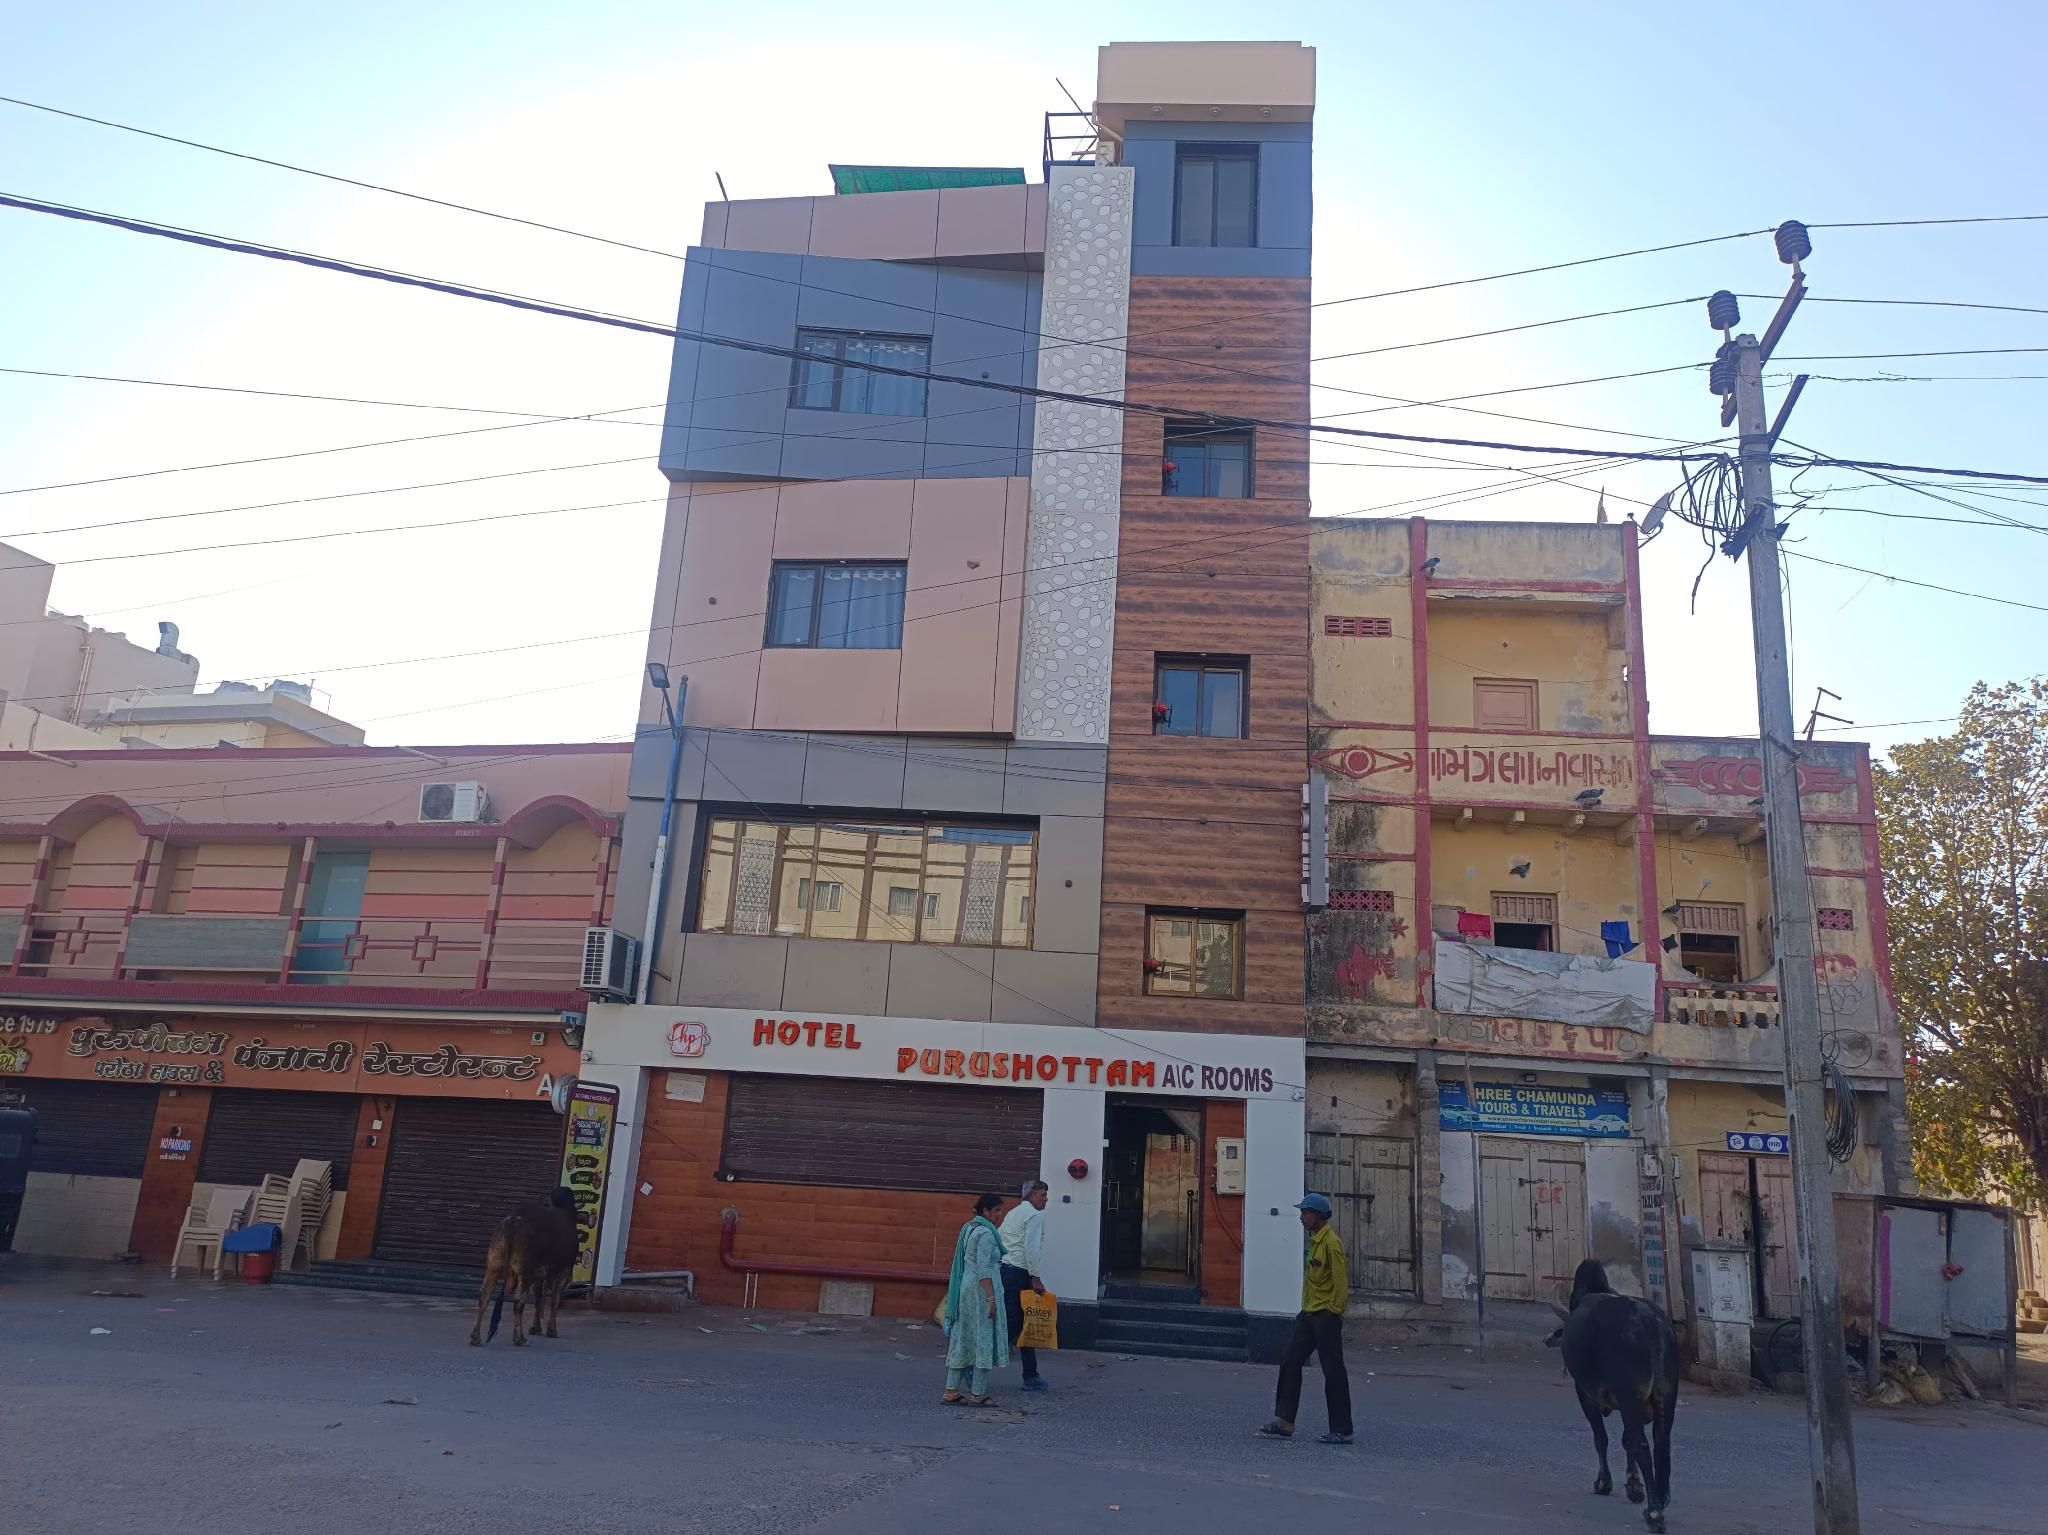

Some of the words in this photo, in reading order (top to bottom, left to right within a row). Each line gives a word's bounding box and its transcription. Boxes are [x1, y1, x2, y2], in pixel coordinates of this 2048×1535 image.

[753, 1018, 862, 1050] HOTEL
[232, 1038, 355, 1073] पंजाबी
[897, 1046, 1155, 1088] PURUSHOTTAM
[1201, 1064, 1274, 1092] ROOMS
[203, 1060, 224, 1082] &
[1477, 1101, 1518, 1115] TOURS
[1521, 1104, 1530, 1115] &
[1533, 1104, 1586, 1118] TRAVELS
[1516, 1089, 1597, 1106] CHAMUNDA
